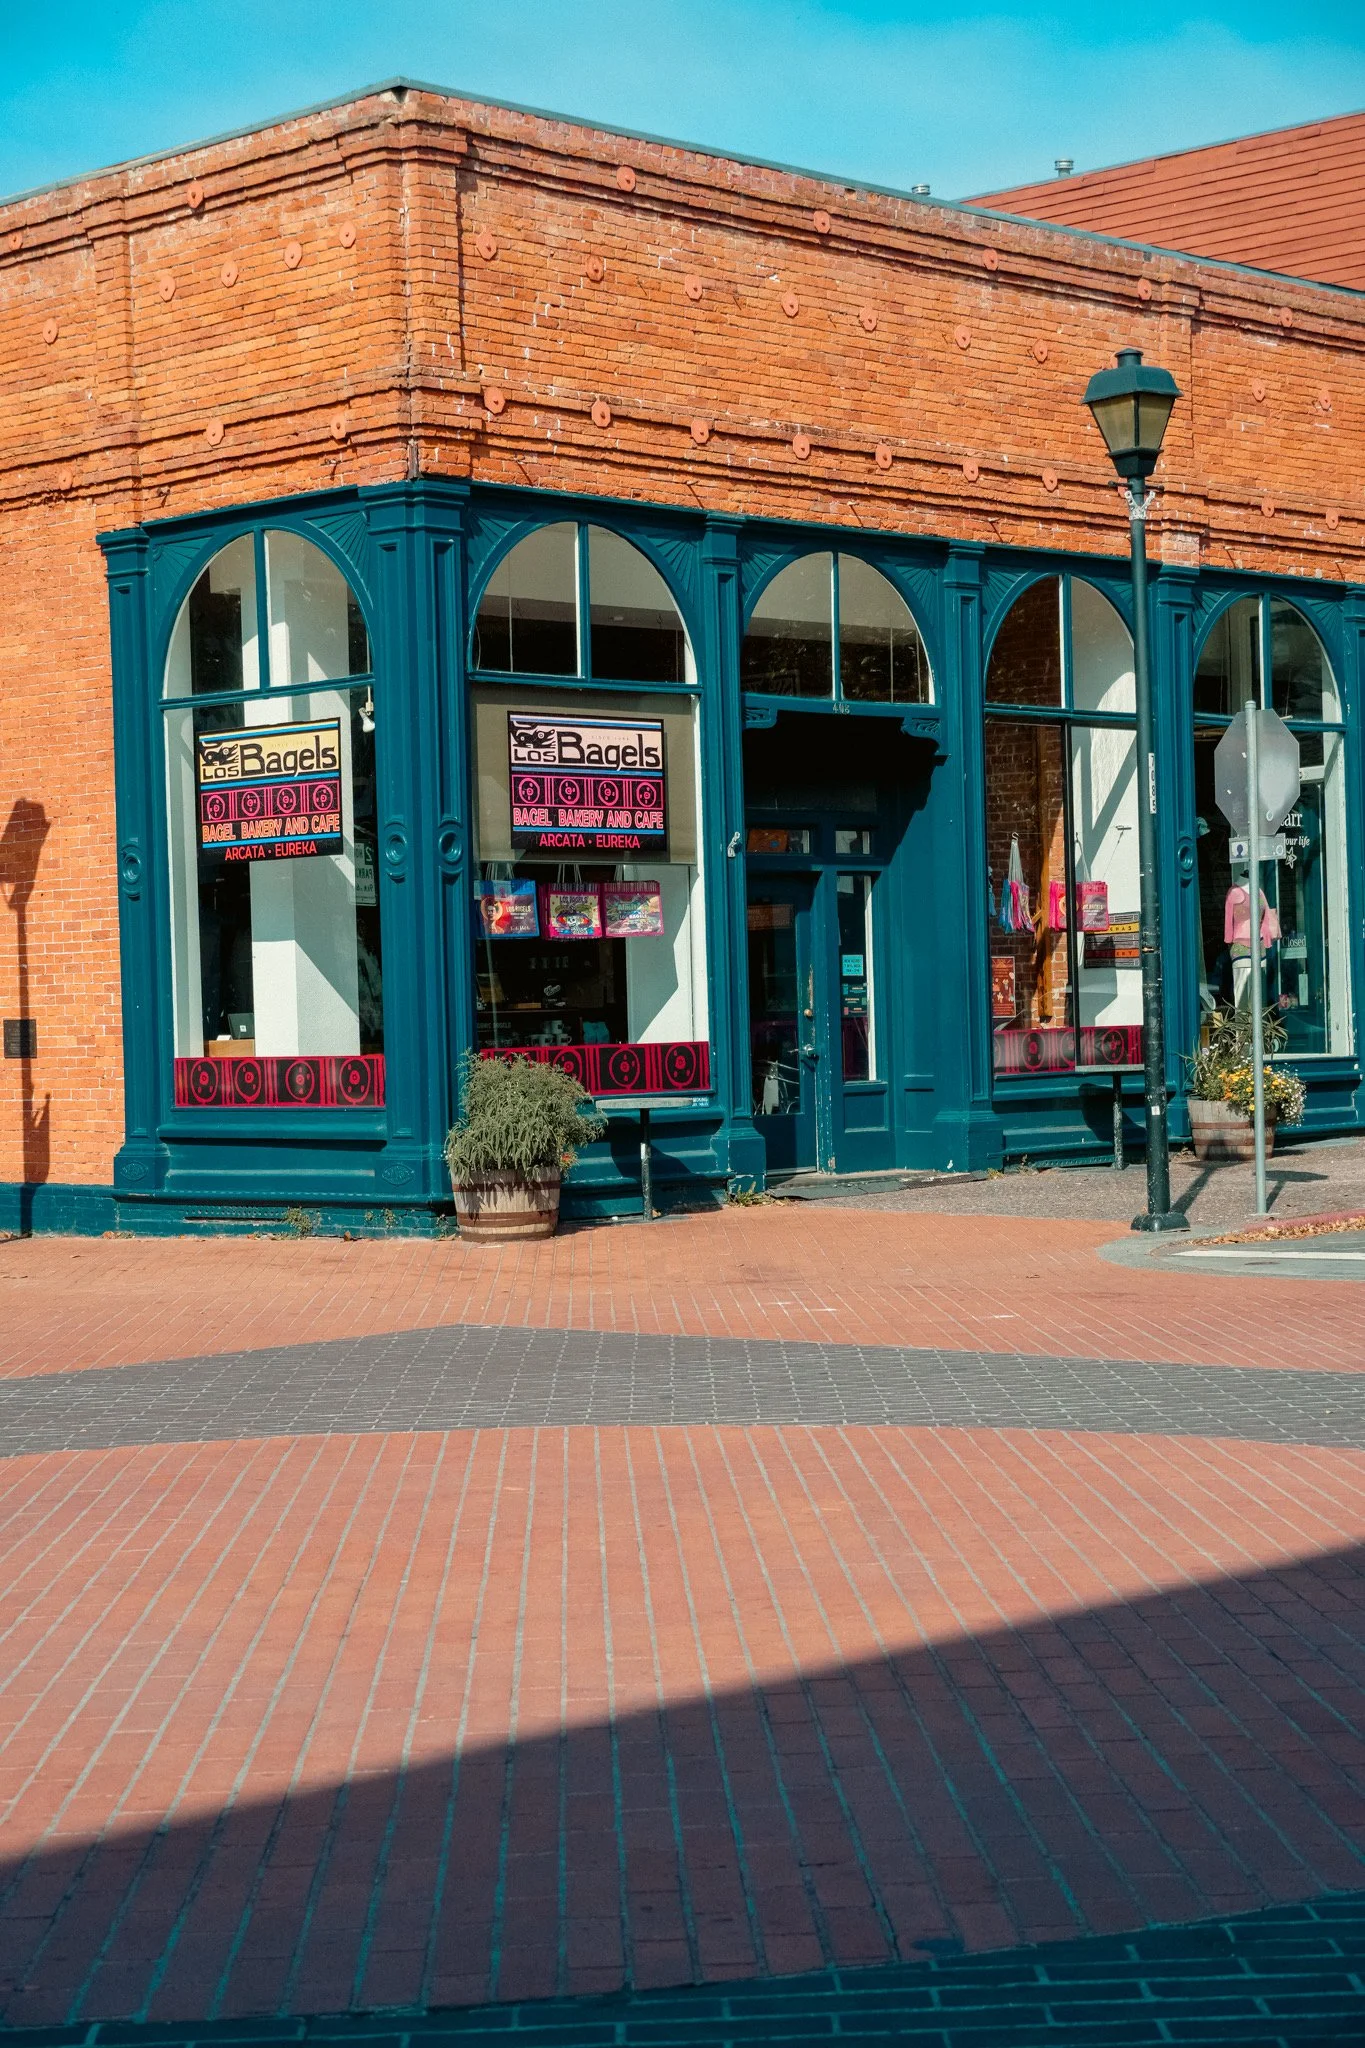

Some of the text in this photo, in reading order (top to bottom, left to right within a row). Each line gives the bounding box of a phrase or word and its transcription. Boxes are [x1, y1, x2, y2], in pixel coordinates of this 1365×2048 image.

[202, 735, 338, 780] LOS Bagels
[513, 731, 661, 771] LOS Bagels
[202, 813, 340, 842] BAGEL BAKERY AND CAFE
[513, 808, 664, 829] BAGEL BAKERY AND CAFE
[224, 840, 318, 860] ARCATA EUREKA
[539, 833, 641, 849] ARCATA EUREKA
[1298, 835, 1311, 848] life
[1282, 935, 1306, 947] Closed
